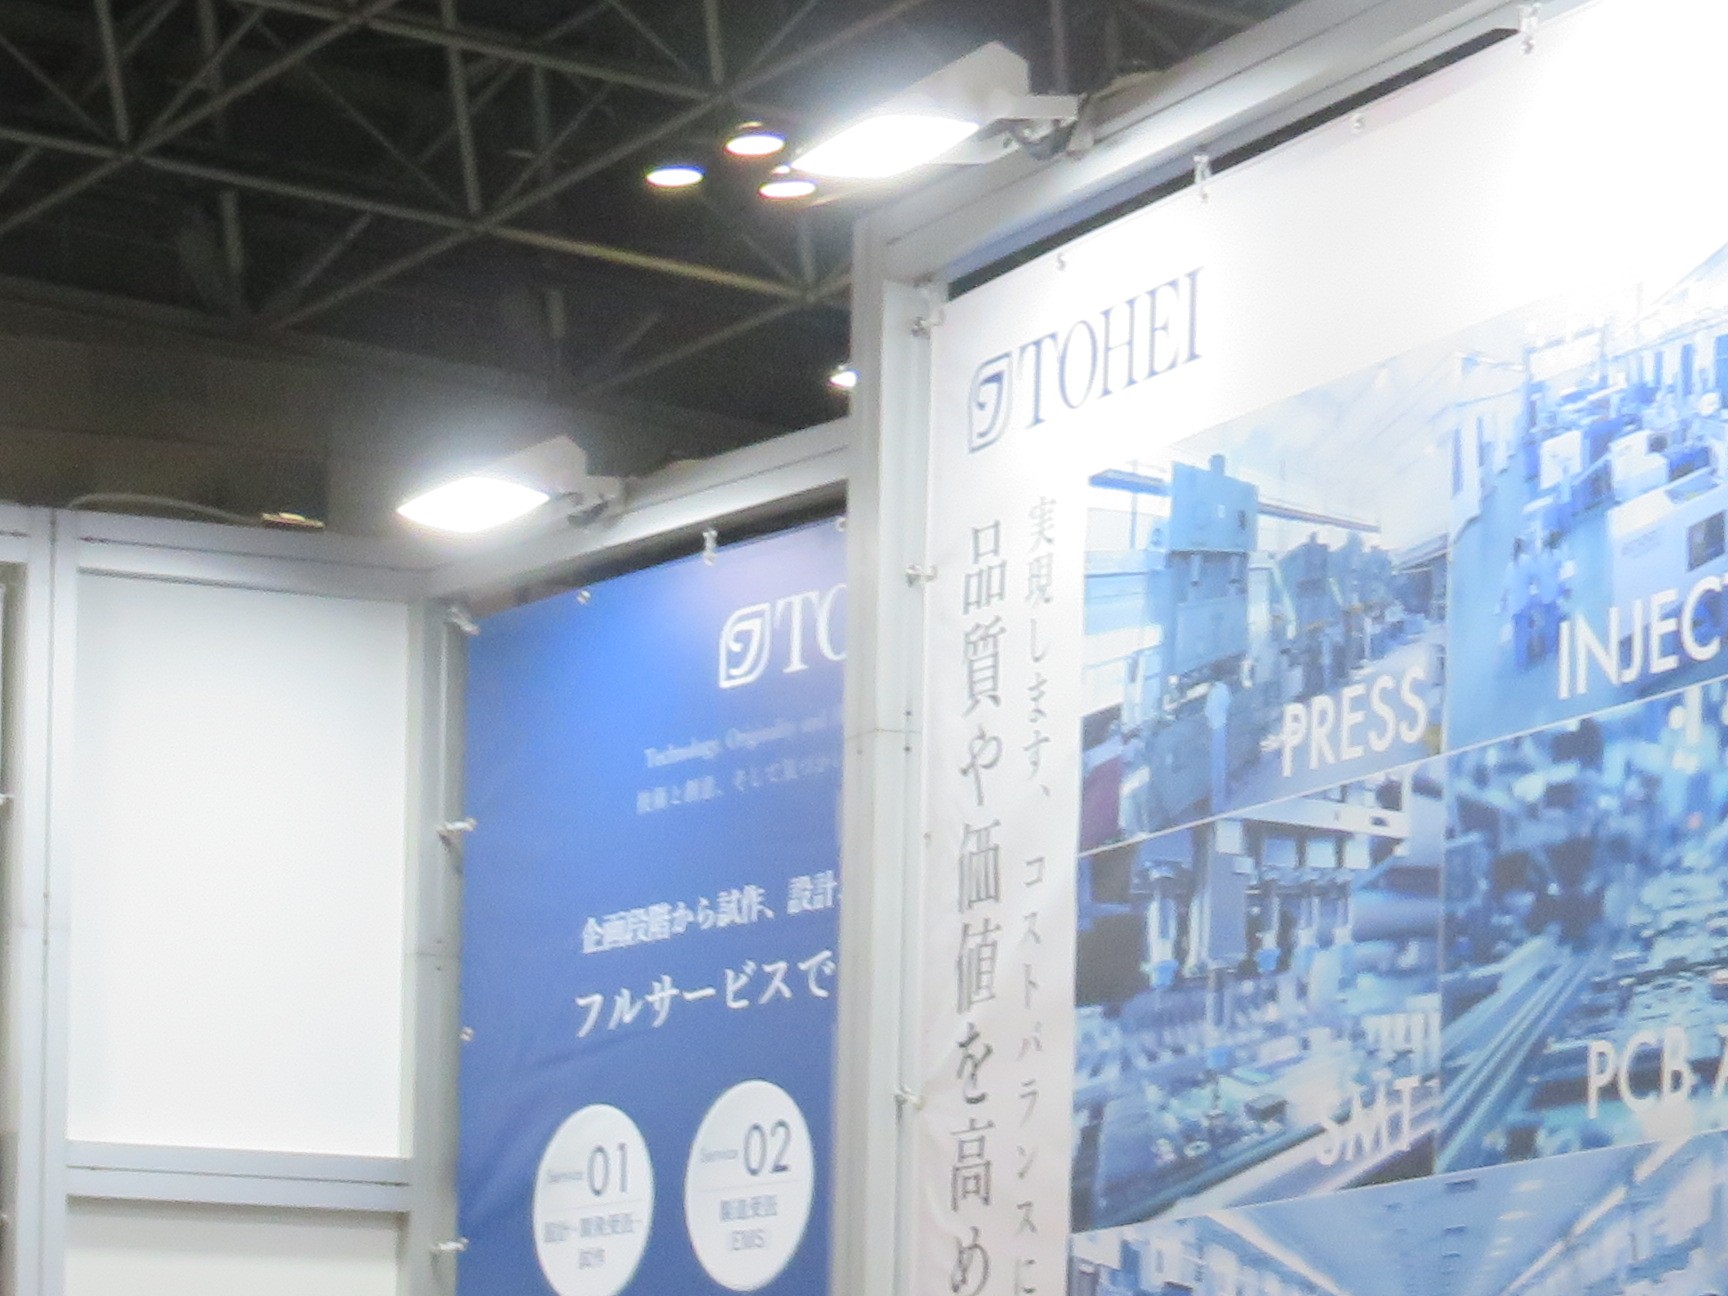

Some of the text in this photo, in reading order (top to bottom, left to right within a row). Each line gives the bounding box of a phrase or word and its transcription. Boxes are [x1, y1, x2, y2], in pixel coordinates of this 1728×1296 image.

[1019, 265, 1204, 430] TOHEI
[1558, 574, 1728, 700] INJEC
[1281, 665, 1430, 777] PRESS
[575, 950, 837, 1038] フルサービスで
[1314, 1073, 1420, 1166] SMT
[1587, 1027, 1694, 1121] PCB
[587, 1141, 629, 1197] 01
[745, 1118, 792, 1177] 02
